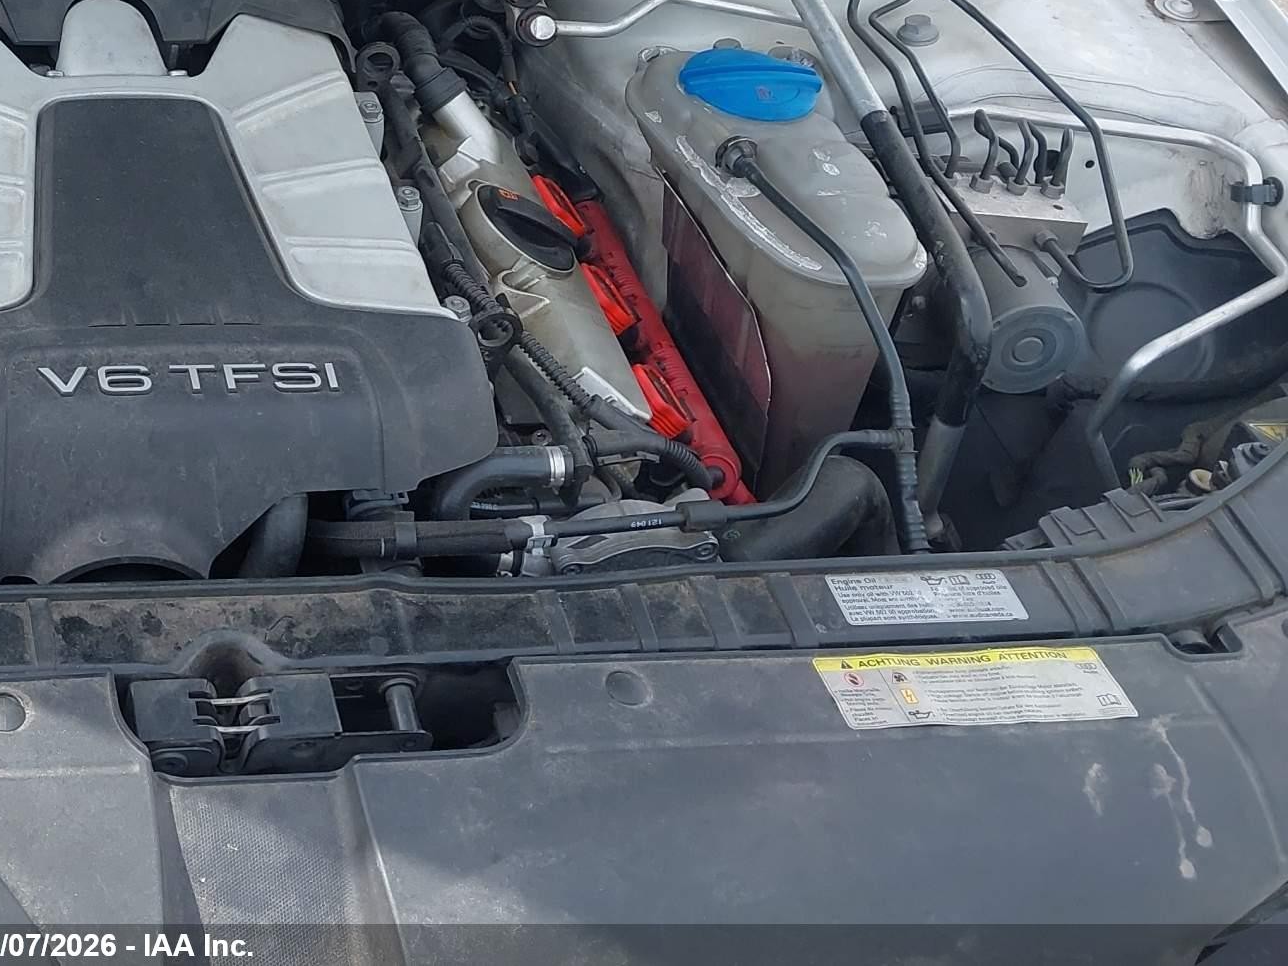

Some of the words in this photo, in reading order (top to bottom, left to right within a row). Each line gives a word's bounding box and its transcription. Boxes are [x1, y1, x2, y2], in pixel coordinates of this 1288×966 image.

[38, 365, 153, 397] V6
[168, 362, 340, 395] TFSI
[831, 578, 862, 586] Engine
[858, 658, 921, 668] ACHTUNG
[925, 655, 992, 666] WARNING
[998, 651, 1068, 661] ATTENTION
